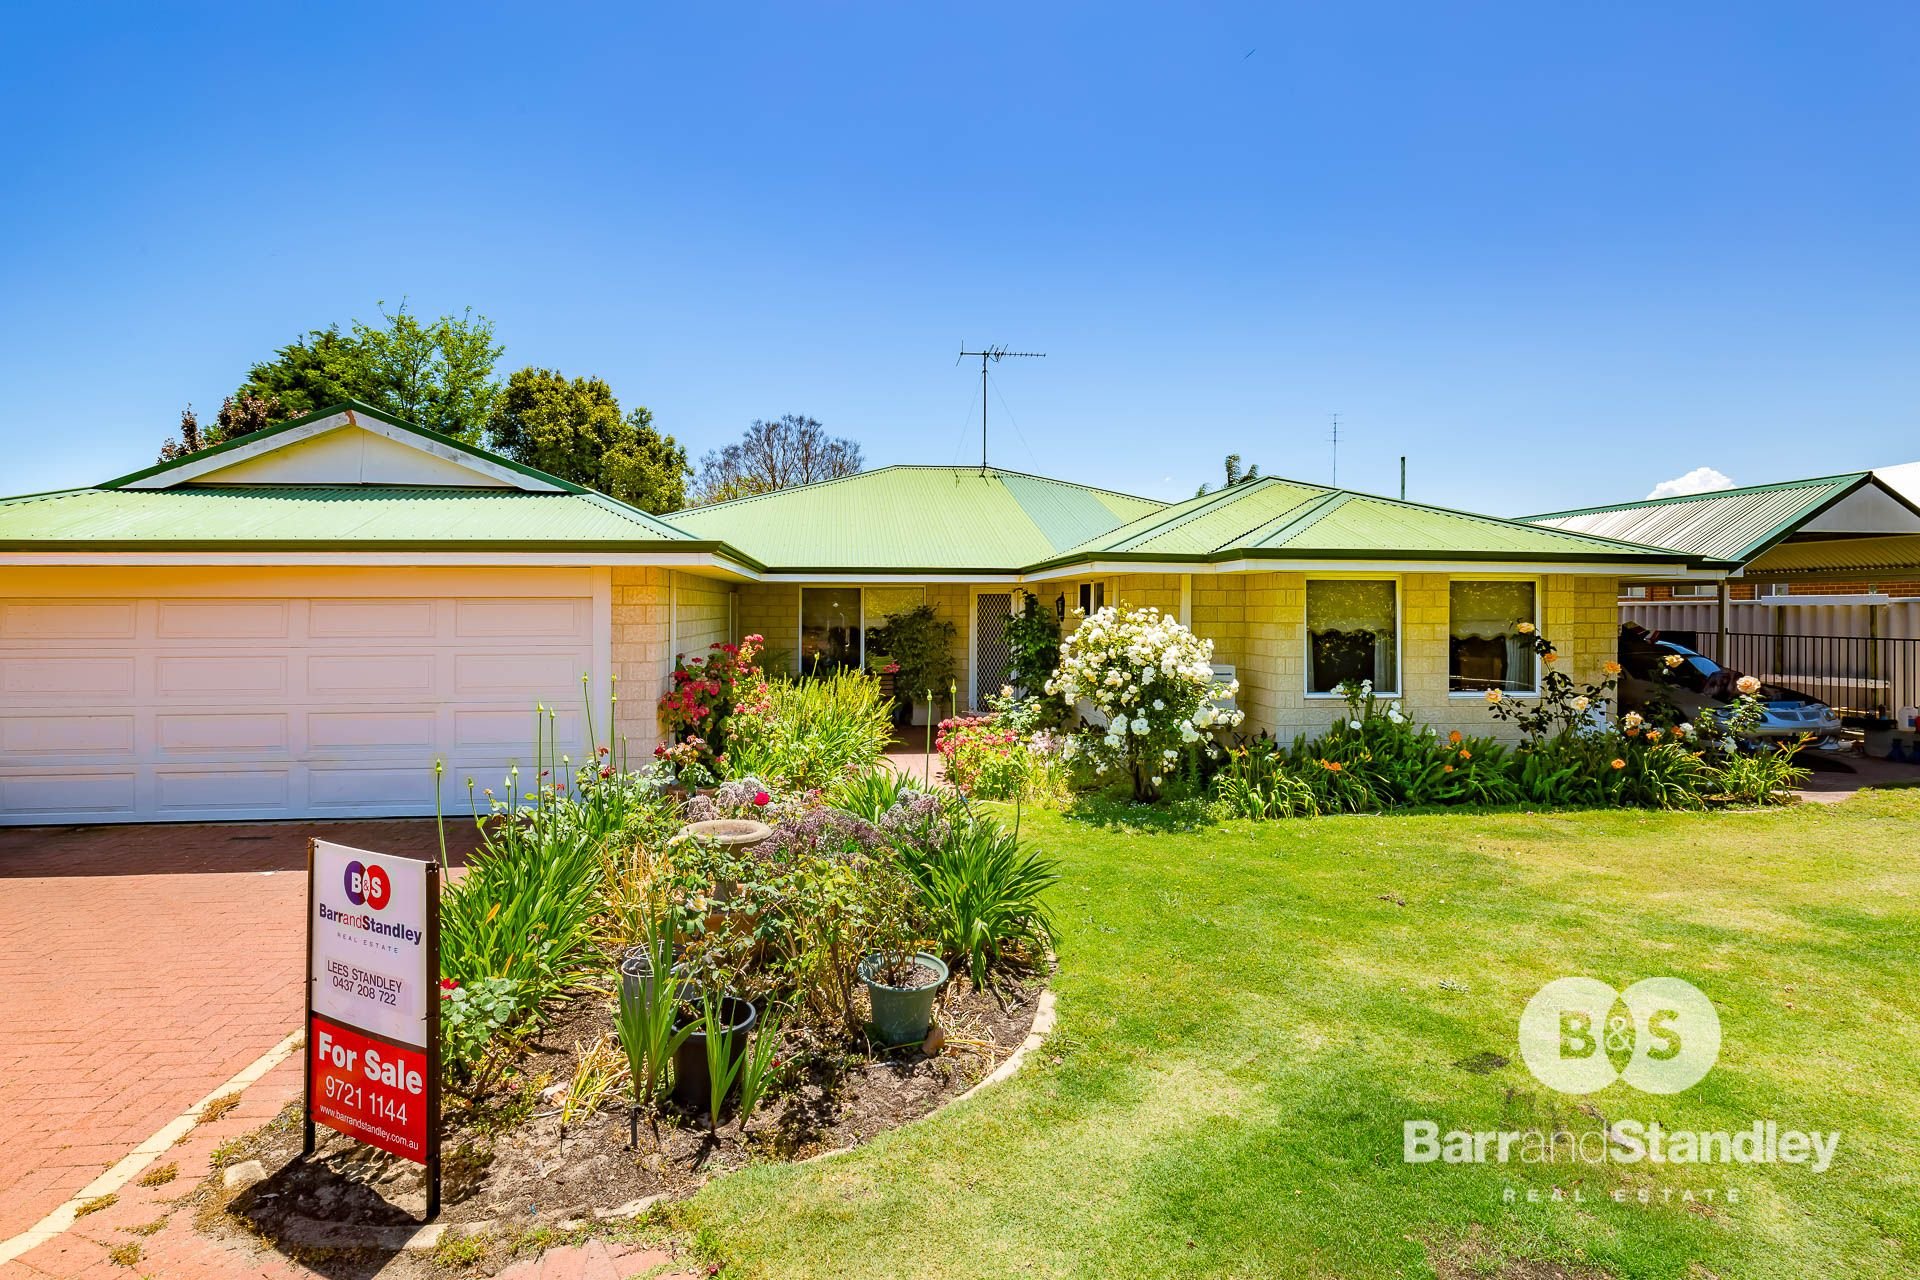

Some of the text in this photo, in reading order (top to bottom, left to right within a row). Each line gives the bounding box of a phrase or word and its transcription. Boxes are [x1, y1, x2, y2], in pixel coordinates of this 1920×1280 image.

[352, 872, 382, 898] B&S
[320, 903, 422, 945] BarrandStandley
[337, 932, 398, 953] REAL ESTATE
[327, 960, 402, 993] LEES STANDLEY
[333, 976, 396, 1006] 0437 208 722
[319, 1032, 422, 1094] For Sale
[325, 1075, 408, 1126] 9721 1144
[320, 1104, 419, 1150] www.barrandstandley.com.au
